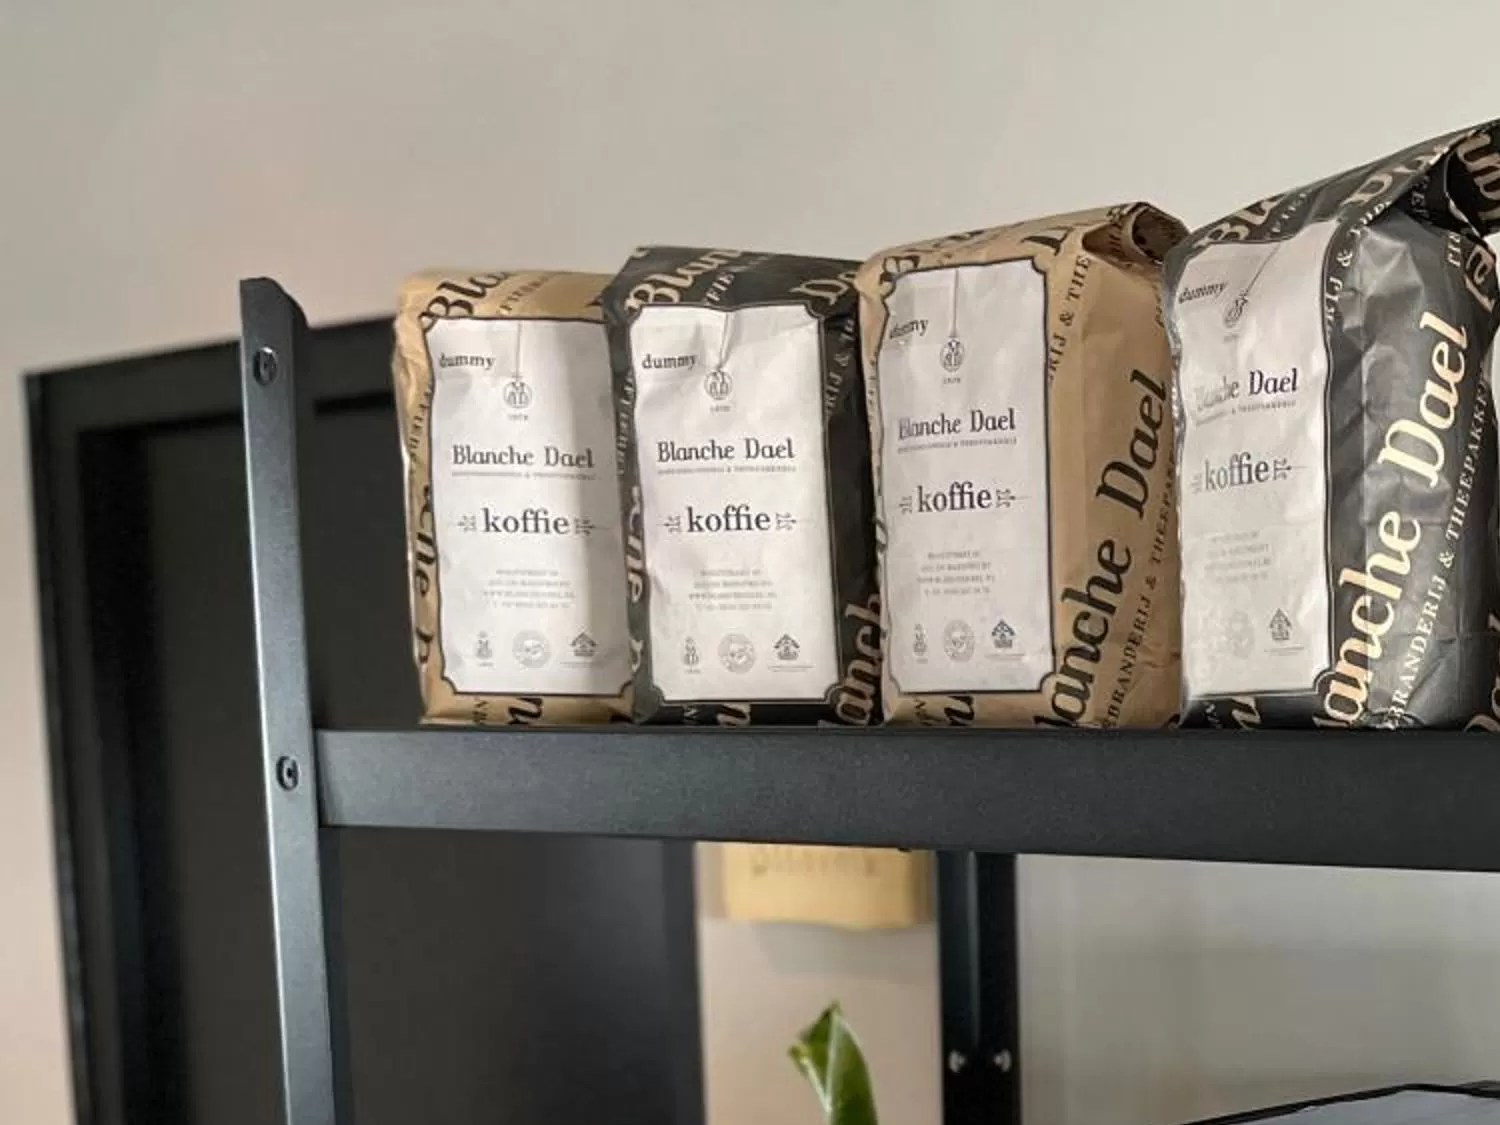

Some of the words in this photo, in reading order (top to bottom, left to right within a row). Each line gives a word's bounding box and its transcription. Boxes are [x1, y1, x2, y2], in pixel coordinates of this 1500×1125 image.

[1177, 280, 1228, 305] dummy
[1059, 310, 1075, 328] &
[438, 353, 496, 370] dummy
[640, 352, 697, 371] dummy
[1248, 366, 1299, 397] Dael
[1376, 310, 1469, 489] Dael
[969, 406, 1017, 433] Dael
[450, 443, 535, 466] Blanche
[543, 445, 597, 469] Dael
[656, 438, 736, 463] Blanche
[743, 436, 796, 460] Dael
[1095, 368, 1167, 520] Dael
[1204, 450, 1270, 493] koffie
[916, 480, 993, 513] koffie
[481, 507, 571, 536] koffie
[686, 503, 772, 534] koffie
[1439, 552, 1456, 569] &
